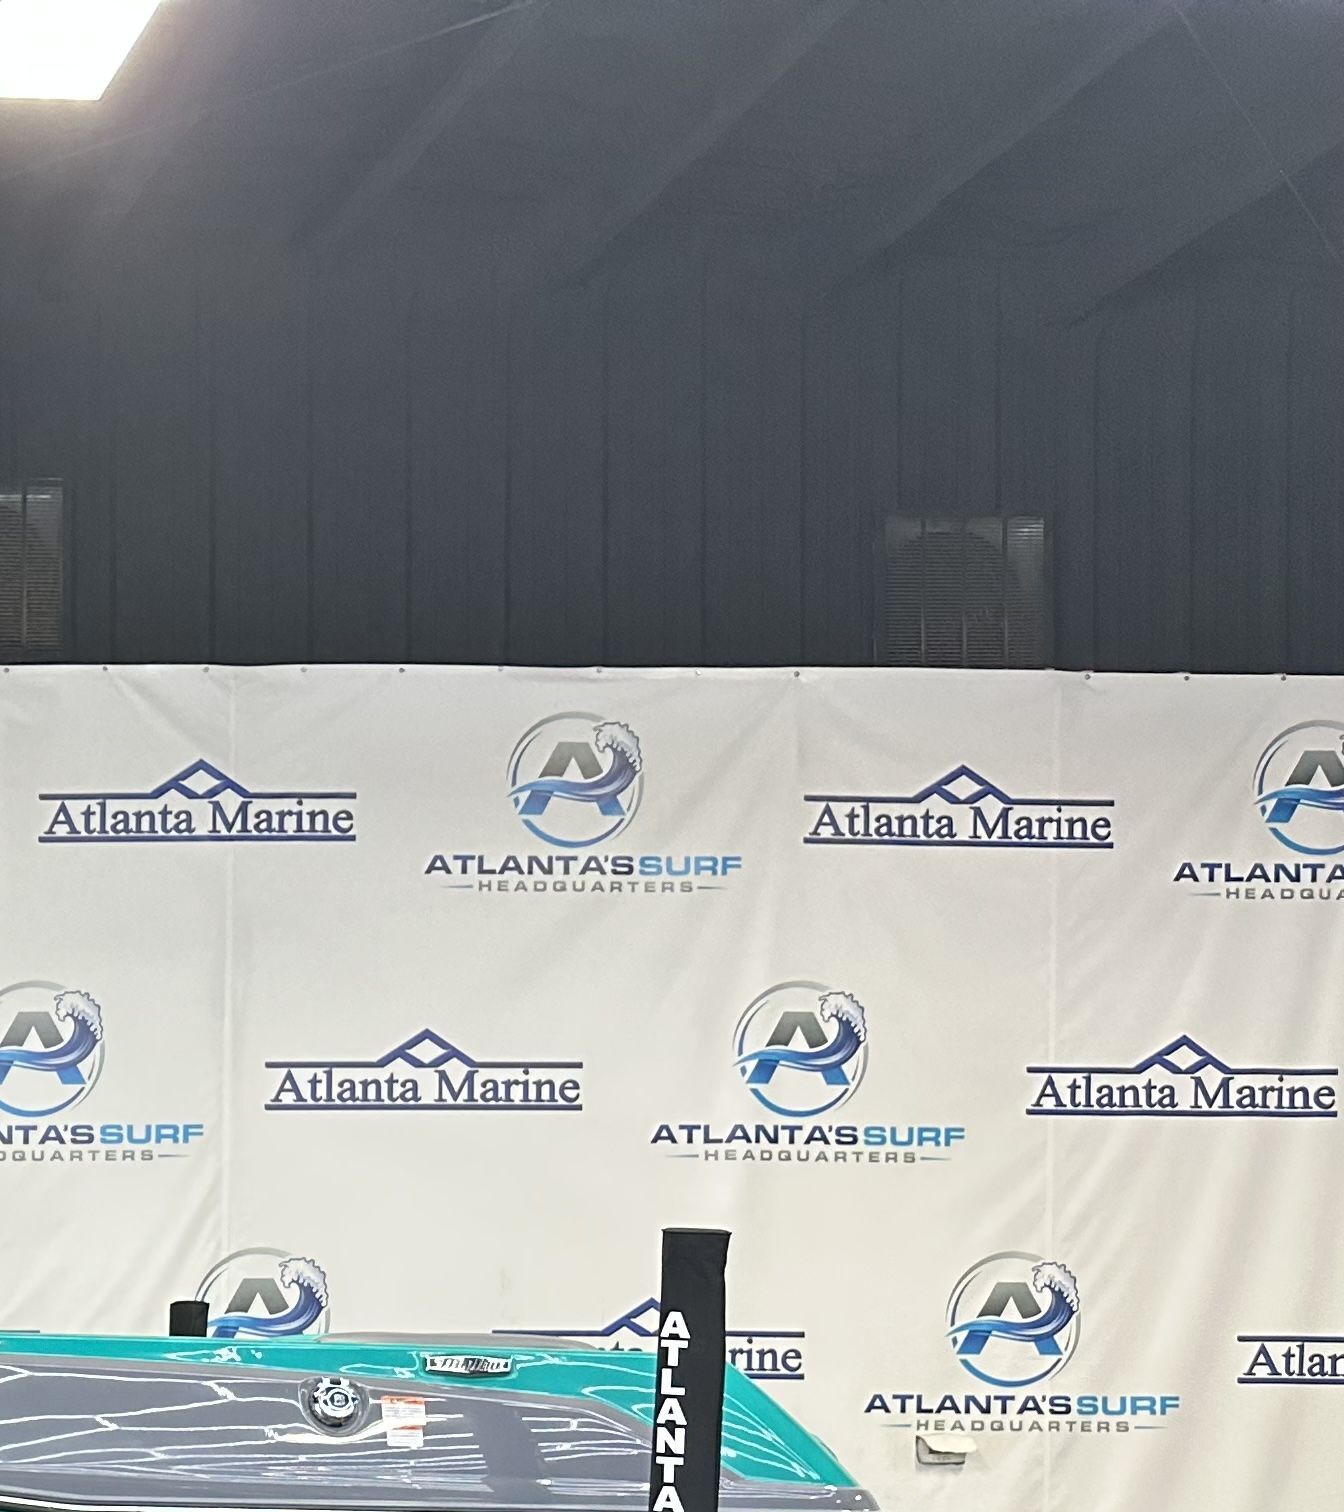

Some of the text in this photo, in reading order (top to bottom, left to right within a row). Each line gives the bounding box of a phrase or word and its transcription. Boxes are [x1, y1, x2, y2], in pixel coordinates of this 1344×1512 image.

[45, 800, 354, 834] Atlanta Marine
[811, 804, 1111, 841] Atlanta Marine
[424, 855, 742, 876] ATLANTA'S SURF
[1173, 862, 1344, 884] ATLANTA
[478, 880, 693, 893] HEADQUARTERS
[270, 1069, 580, 1103] Atlanta Marine
[1032, 1075, 1336, 1110] Atlanta Marine
[100, 1124, 204, 1144] SURF
[650, 1124, 965, 1147] ATLANTA'S SURF
[704, 1149, 916, 1163] HEADQUARTERS
[728, 1338, 802, 1372] rine
[1242, 1343, 1344, 1377] Atlan
[864, 1394, 1182, 1417] ATLANTA'S SURF
[916, 1419, 1129, 1435] HEADQUARTERS
